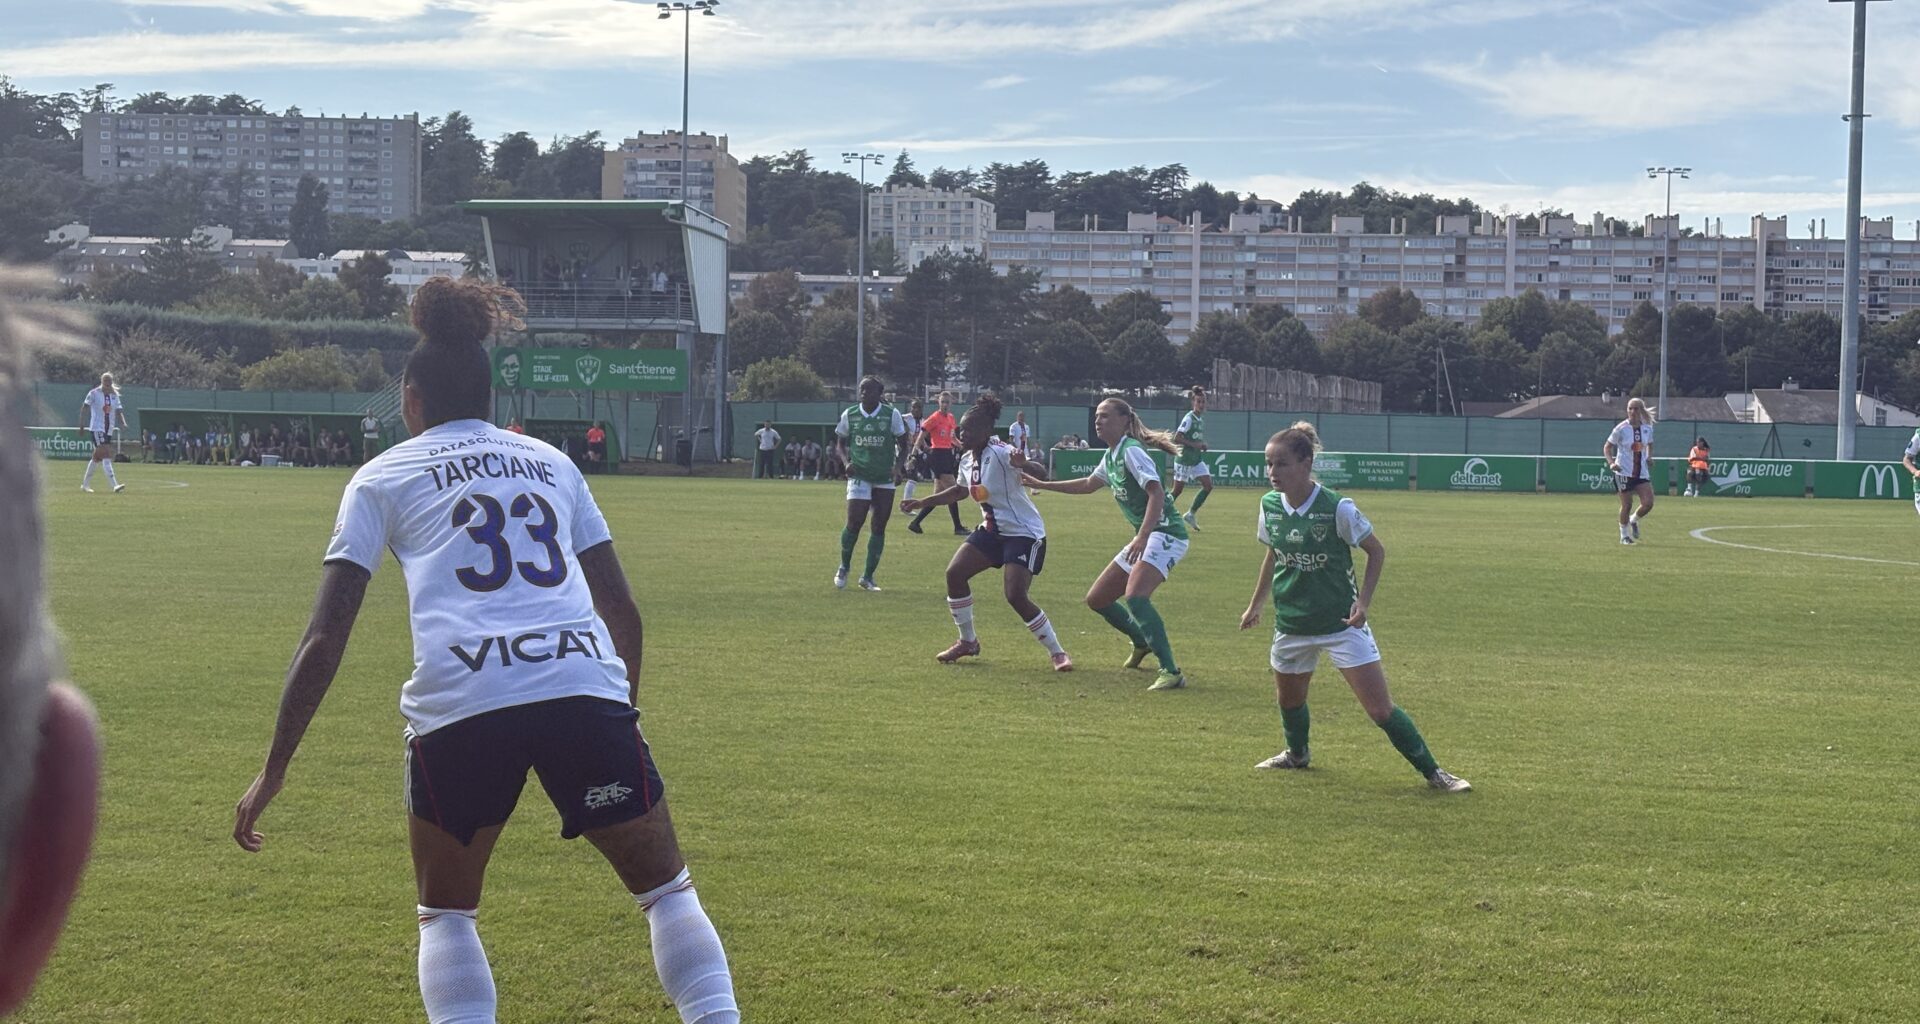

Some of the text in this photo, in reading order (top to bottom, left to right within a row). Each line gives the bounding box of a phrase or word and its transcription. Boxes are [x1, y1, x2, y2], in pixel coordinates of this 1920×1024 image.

[533, 365, 552, 373] STADE
[429, 437, 536, 457] DATASOLUTION
[424, 452, 557, 491] TARCIANE
[1450, 471, 1502, 486] deltanet
[1740, 463, 1793, 477] avenue
[1735, 484, 1752, 495] pro
[451, 492, 568, 593] 33
[448, 630, 601, 672] VICAT
